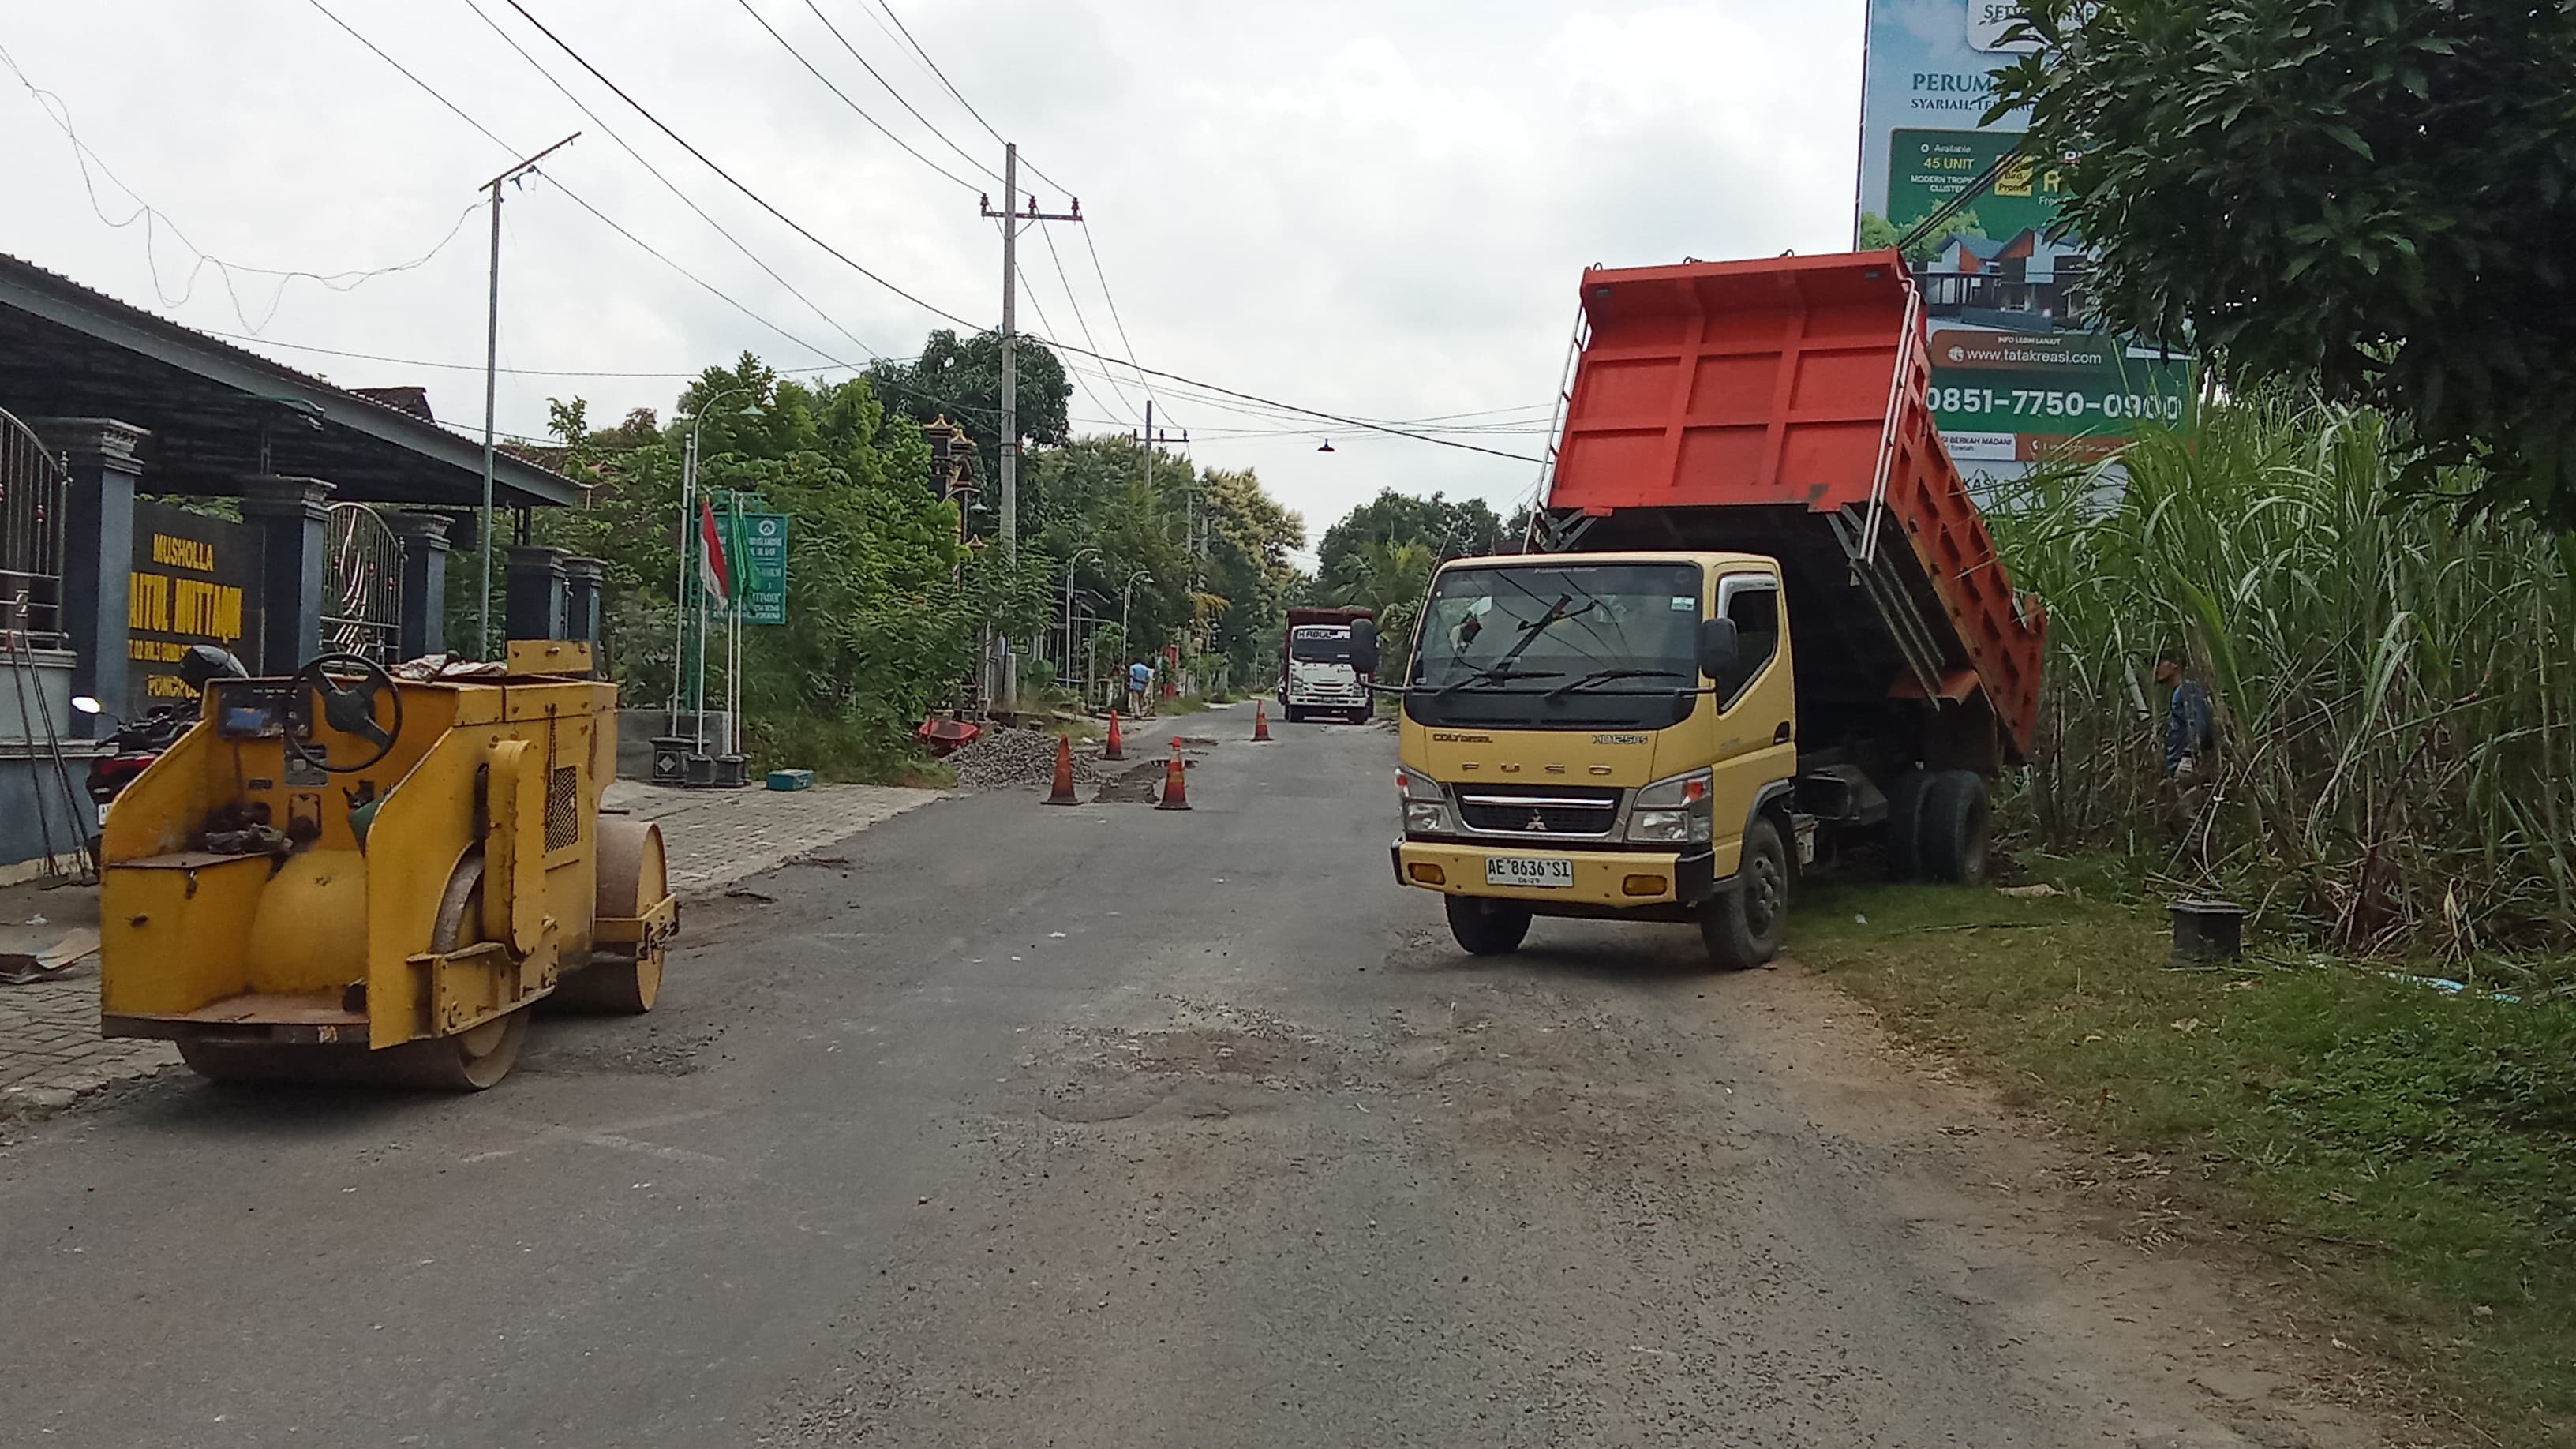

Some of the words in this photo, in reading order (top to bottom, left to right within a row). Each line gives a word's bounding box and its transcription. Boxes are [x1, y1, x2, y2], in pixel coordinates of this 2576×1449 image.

[1912, 73, 1992, 92] PERUM
[1934, 144, 1971, 153] Available
[1923, 157, 1941, 169] 45
[1944, 158, 1975, 170] UNIT
[1911, 175, 1945, 184] MODERN
[1967, 348, 2102, 364] www.tatakreasi.com
[153, 533, 214, 572] MUSHOLLA
[1432, 732, 1462, 742] COLT
[1462, 762, 1612, 776] FUSO
[1488, 859, 1506, 874] AE
[1511, 860, 1545, 876] 8636
